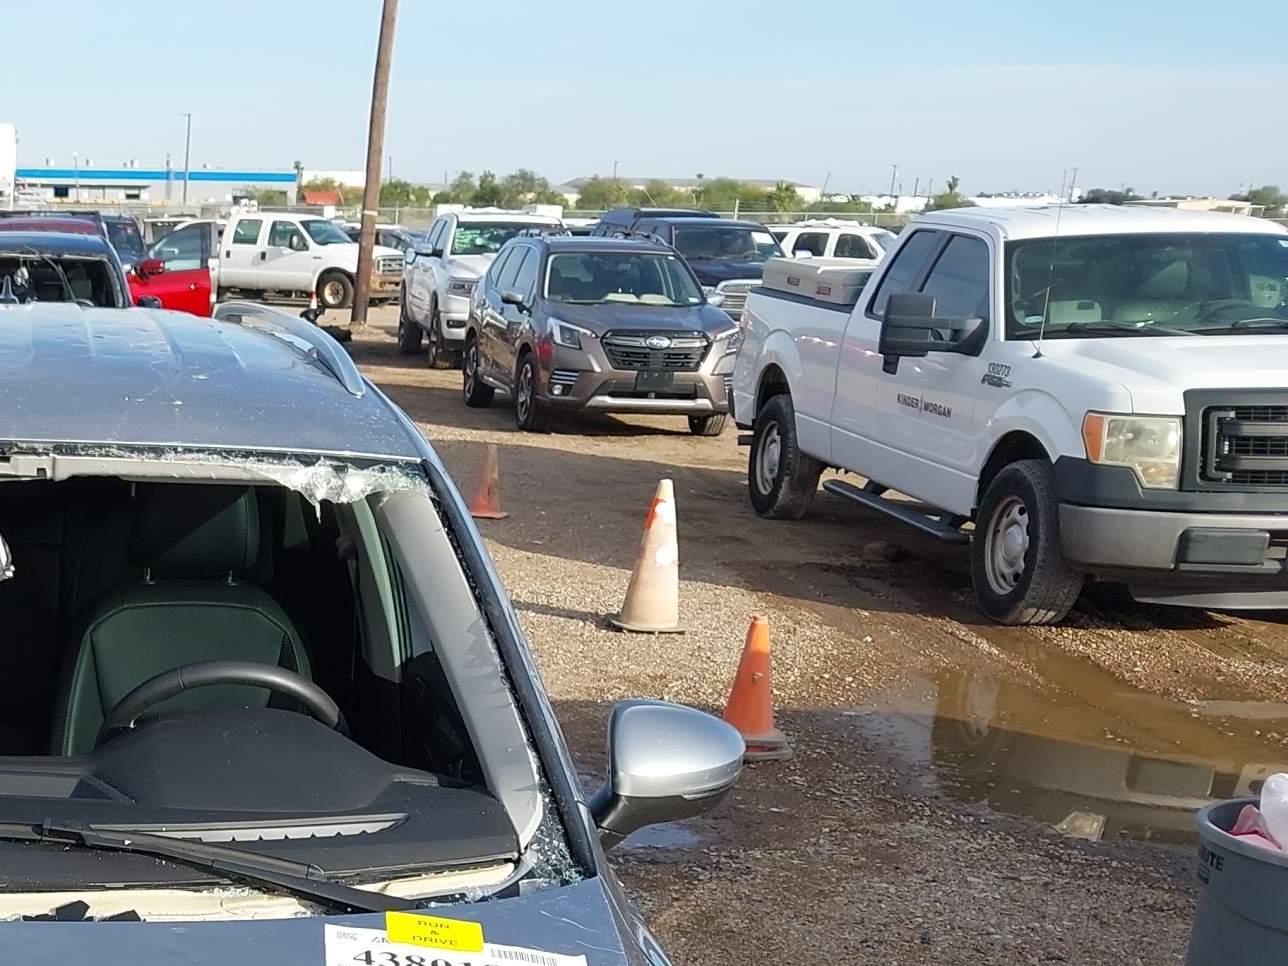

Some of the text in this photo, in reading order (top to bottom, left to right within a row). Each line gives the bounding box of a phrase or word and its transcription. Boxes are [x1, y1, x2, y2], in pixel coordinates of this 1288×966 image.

[896, 393, 952, 418] KINDER MORGAN
[417, 919, 450, 929] RUN
[412, 935, 458, 946] DRIVE
